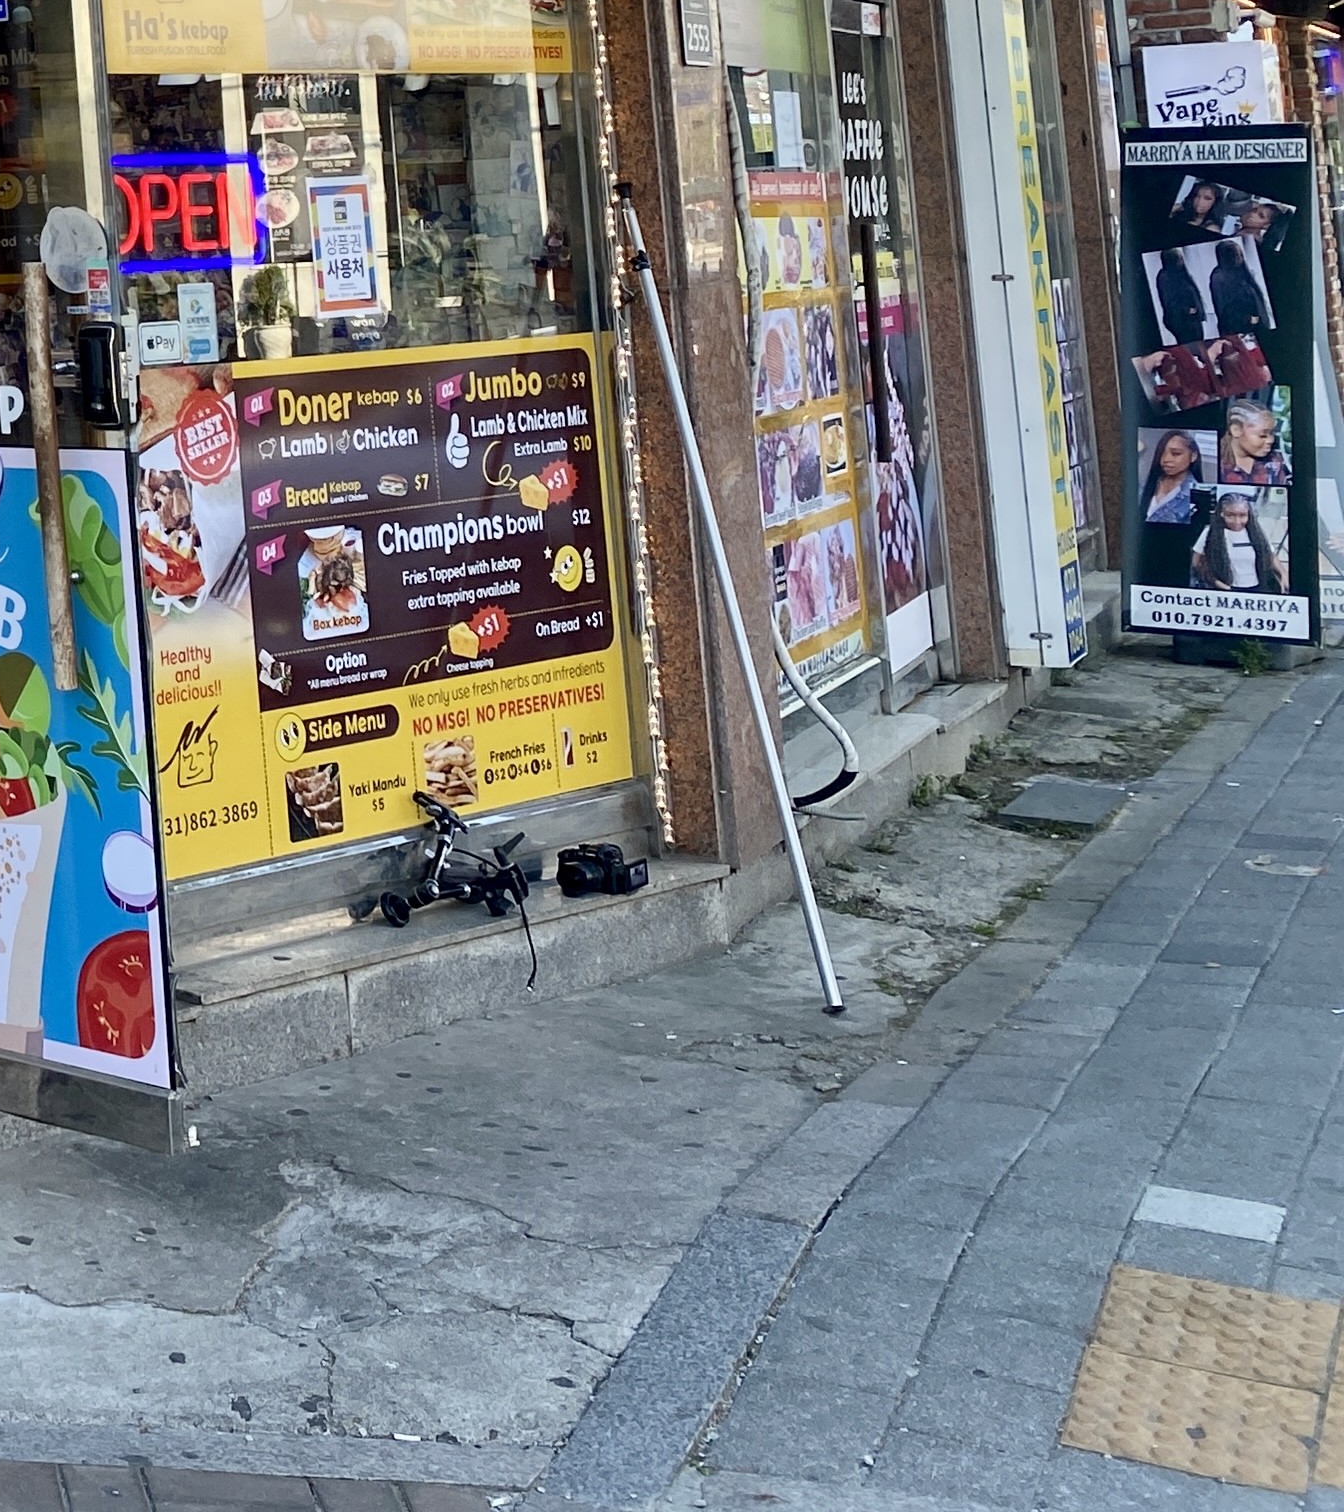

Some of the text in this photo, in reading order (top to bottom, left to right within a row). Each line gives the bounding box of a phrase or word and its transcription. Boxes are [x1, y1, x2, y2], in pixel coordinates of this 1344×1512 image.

[123, 8, 229, 46] Ha's kebap
[687, 22, 710, 53] 2553
[418, 45, 435, 59] NO
[466, 45, 482, 59] NO
[1156, 99, 1218, 123] Vape
[1127, 140, 1305, 163] MARRIYA HAIR DESIGNER
[324, 232, 362, 256] 상품권
[327, 257, 365, 281] 사용처
[155, 336, 175, 352] Pay
[465, 367, 586, 403] Jumbo $9
[278, 387, 423, 426] Doner kebap $6
[183, 414, 224, 445] BEST
[470, 404, 589, 438] Lamb Chicken Mix
[187, 431, 231, 461] SELLER
[280, 425, 419, 458] Lamb Chicken
[514, 434, 592, 457] Extra Lamb $10
[285, 473, 429, 508] Bread Kebap $7
[378, 508, 591, 555] Champions bowl $12
[402, 556, 522, 587] Fries Topped with kebap
[407, 579, 521, 611] extra available
[1140, 590, 1300, 614] Contact MARRIYA
[535, 610, 604, 637] On Bread +$1
[1151, 610, 1289, 632] 010.7921.4397
[160, 646, 212, 666] Healthy
[325, 651, 367, 675] Option
[175, 663, 201, 684] and
[156, 679, 222, 706] delicious!!
[409, 669, 551, 709] We only use fresh herbs and
[412, 683, 605, 736] NO MSG! NO PRESERVATIVES!
[309, 711, 387, 742] Side Menu
[579, 731, 608, 746] Drinks
[490, 741, 547, 763] French Fries
[348, 775, 407, 798] Yaki Mandu
